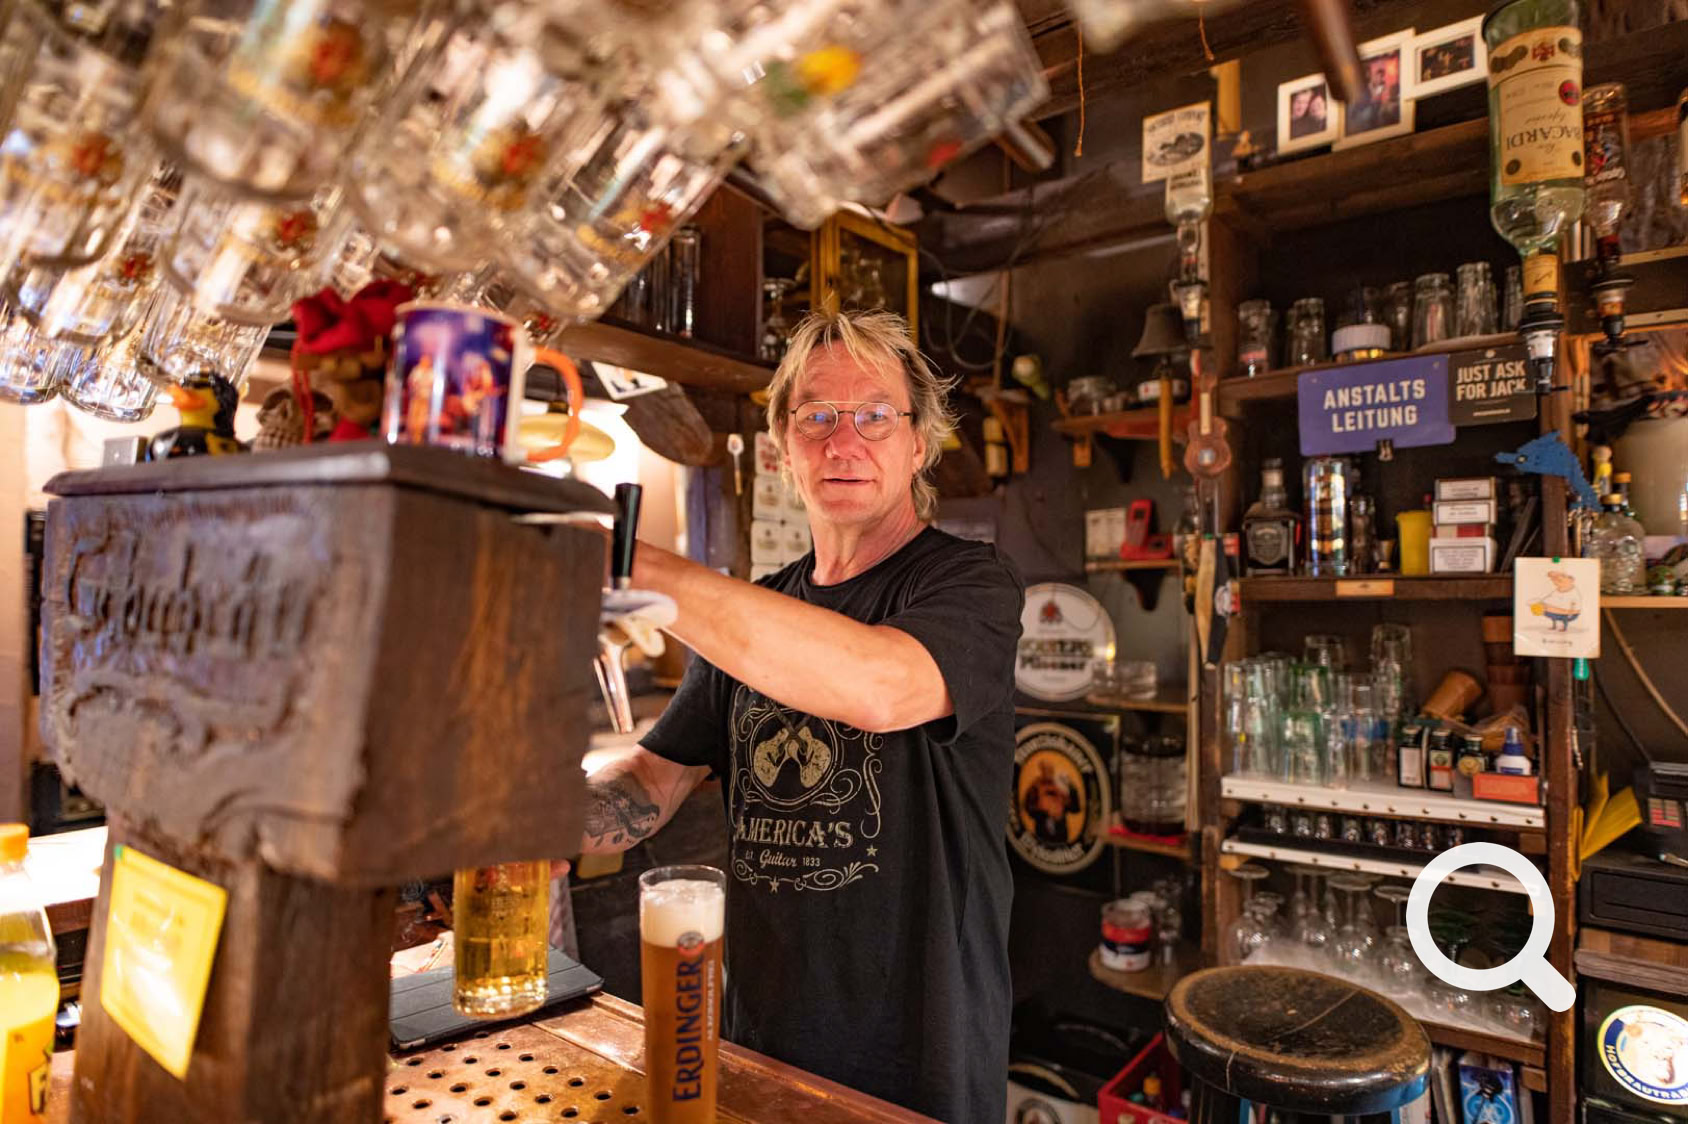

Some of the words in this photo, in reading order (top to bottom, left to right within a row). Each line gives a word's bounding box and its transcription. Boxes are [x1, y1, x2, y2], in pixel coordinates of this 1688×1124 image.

[1506, 125, 1581, 150] BACARDI
[1456, 364, 1491, 384] JUST
[1495, 360, 1526, 378] ASK
[1323, 379, 1426, 410] ANSTALTS
[1456, 382, 1486, 401] FOR
[1489, 378, 1527, 398] JACK
[1332, 404, 1418, 433] LEITUNG
[735, 816, 853, 848] AMERICA'S
[760, 849, 798, 869] Guitar
[802, 856, 821, 867] 1833
[672, 954, 705, 1103] ERDINGER
